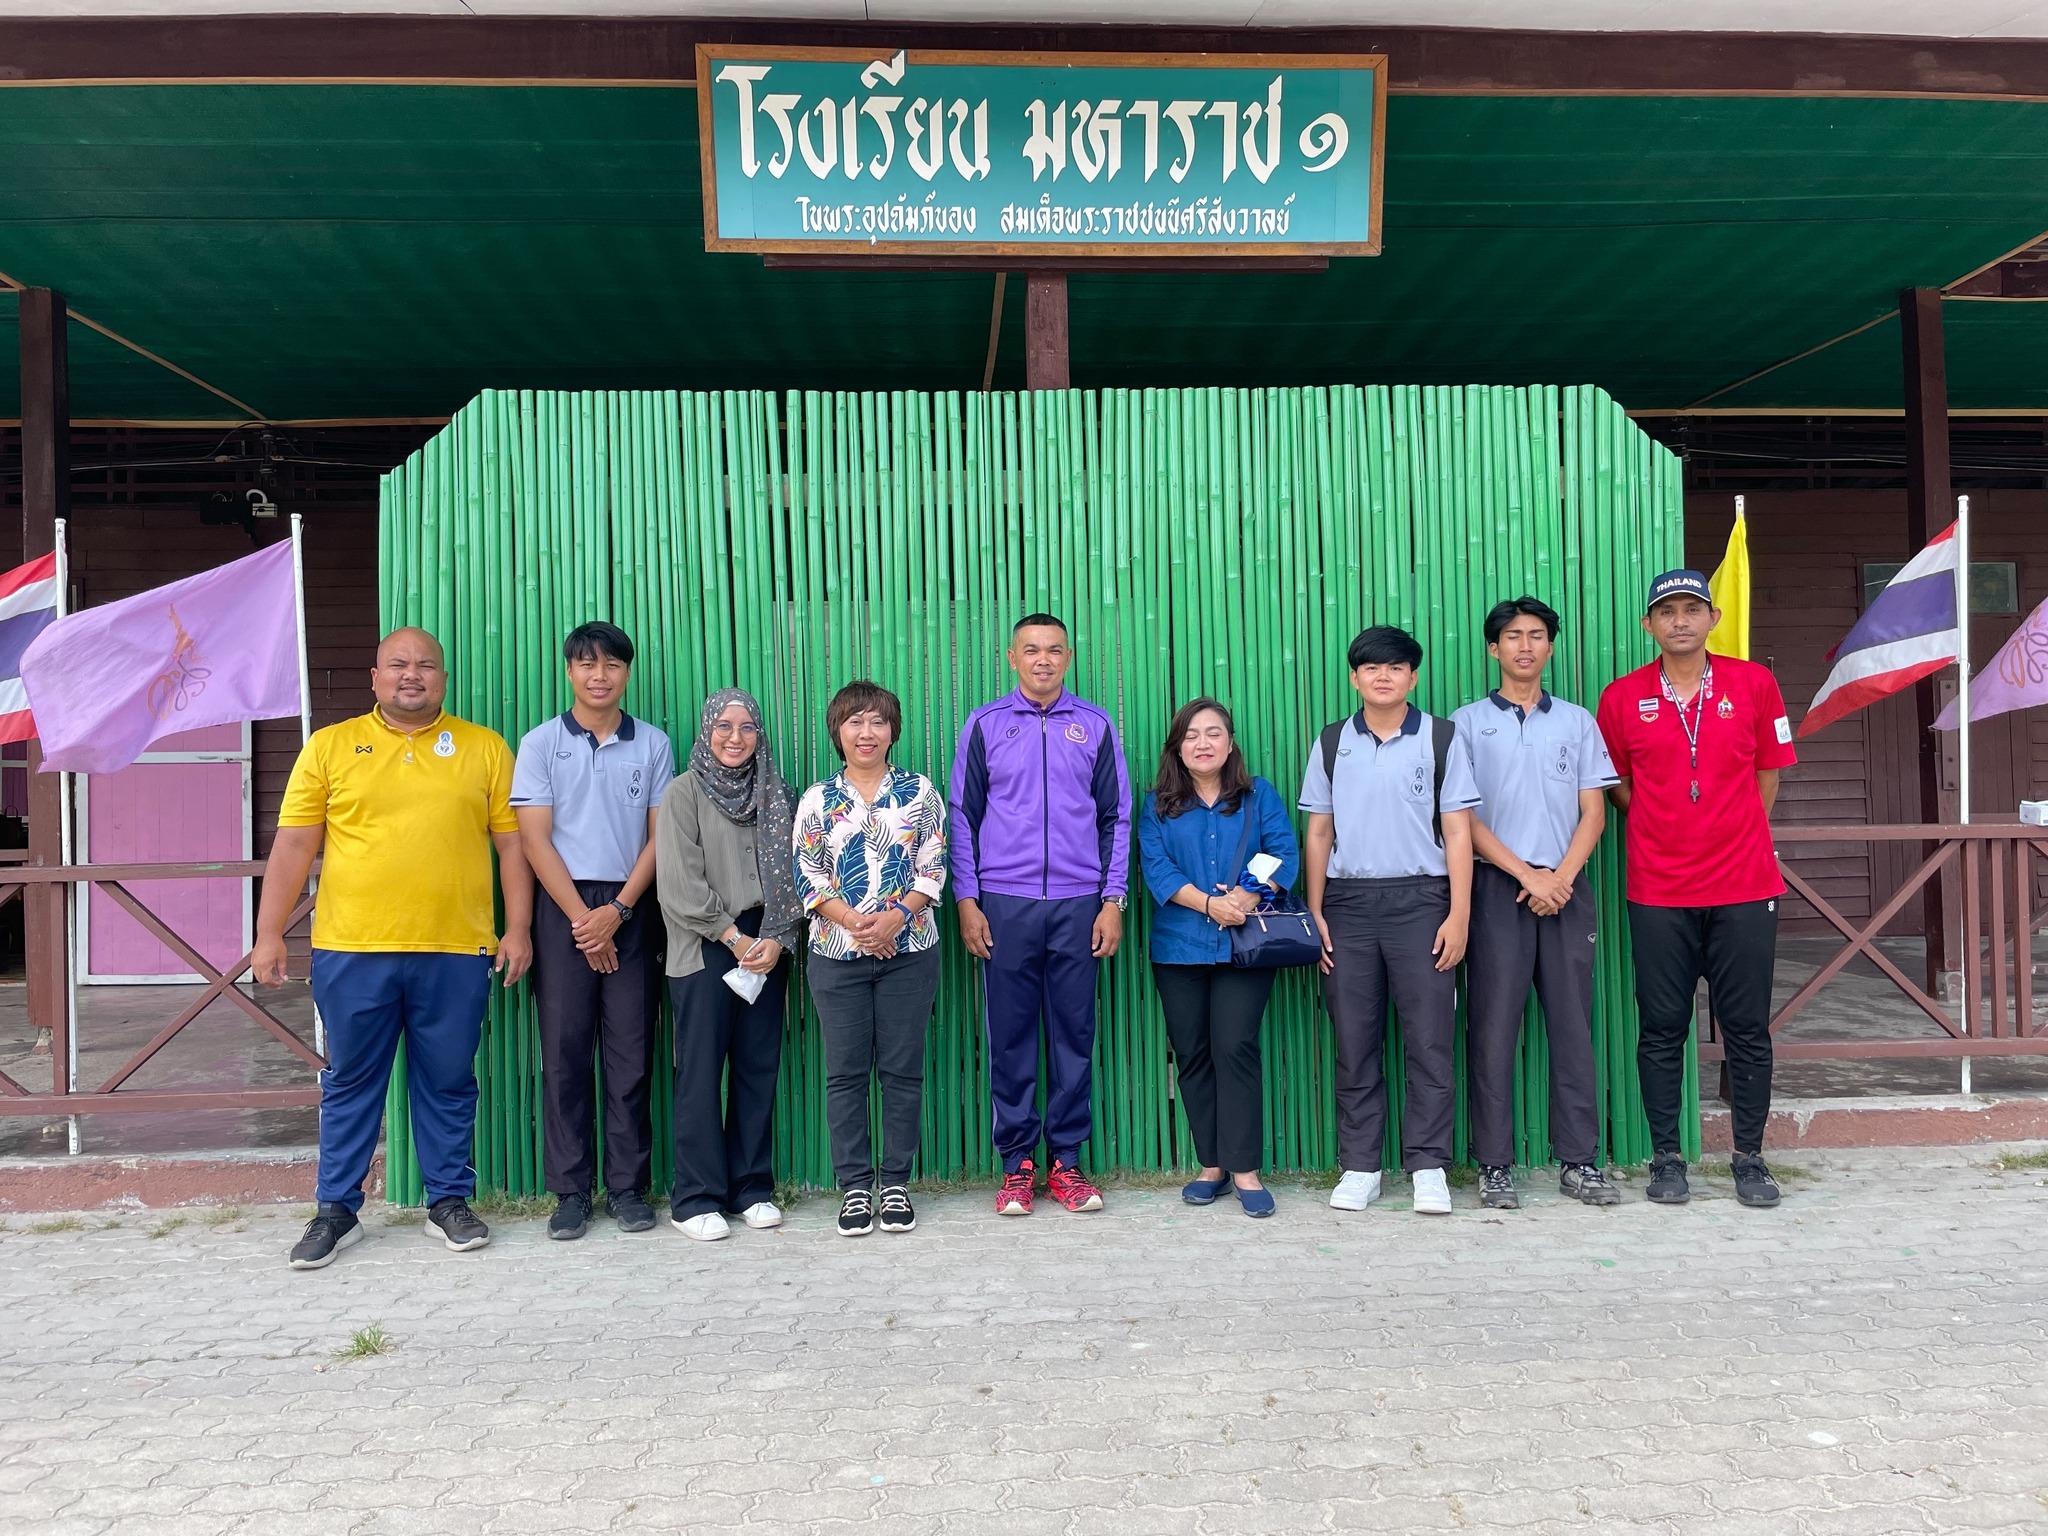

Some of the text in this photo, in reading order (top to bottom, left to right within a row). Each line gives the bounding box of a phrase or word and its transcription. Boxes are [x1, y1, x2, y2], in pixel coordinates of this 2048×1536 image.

[715, 49, 1349, 184] โรงเรียน มหาราช ๑
[794, 190, 1296, 246] ในพระอุปถัมภ์ของ สมเด็จพระราชชนนีศรีสังวาลย์
[1656, 577, 1702, 592] THAILAND
